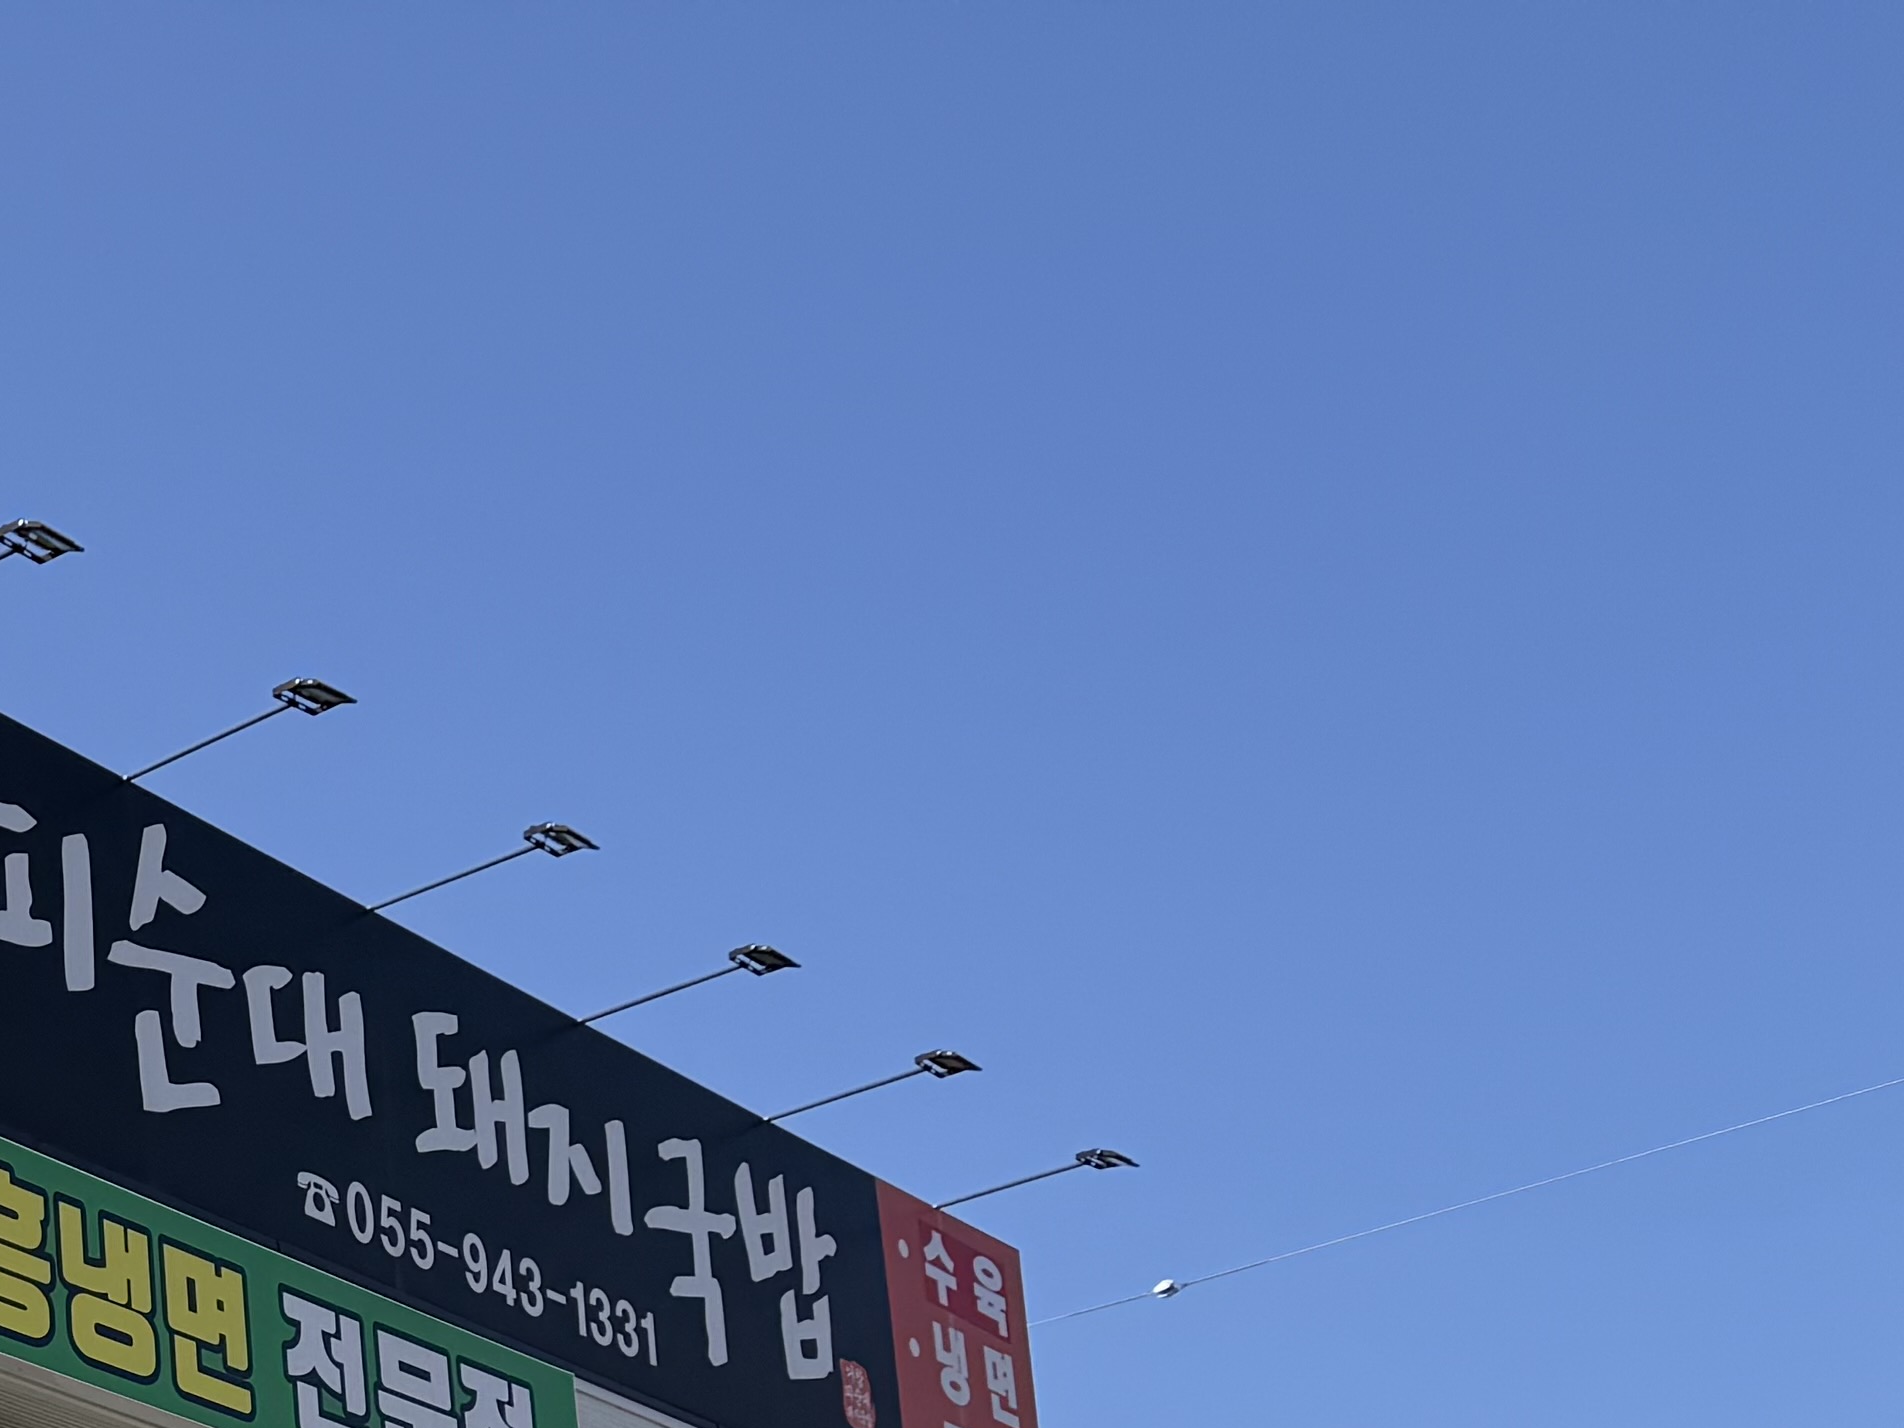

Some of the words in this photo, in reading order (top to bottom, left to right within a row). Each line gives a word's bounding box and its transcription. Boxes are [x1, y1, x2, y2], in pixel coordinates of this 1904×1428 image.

[346, 1180, 658, 1367] 055-943-1331
[410, 1010, 837, 1382] 돼지국밥
[923, 1229, 1009, 1338] 수육
